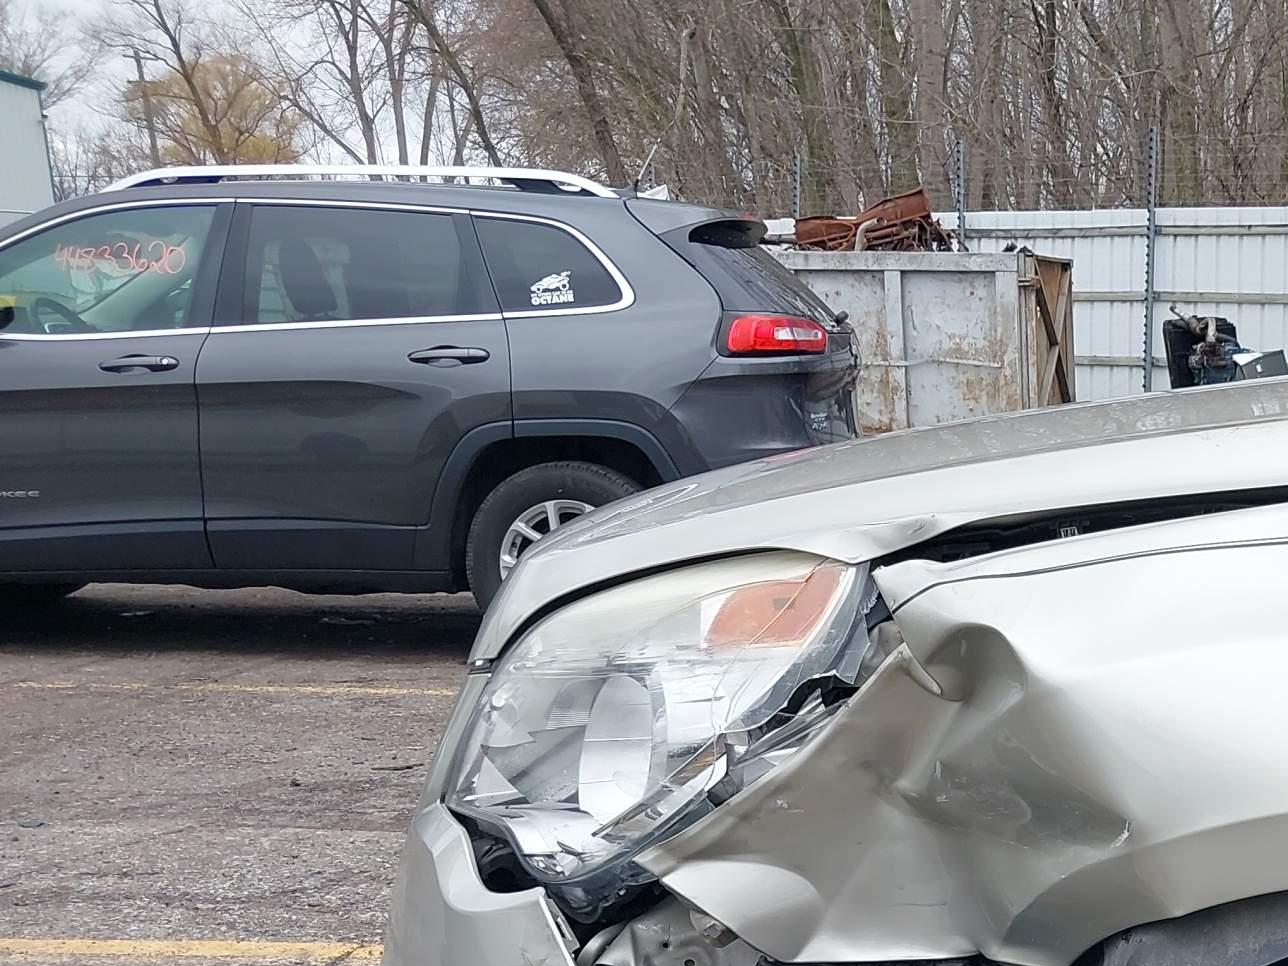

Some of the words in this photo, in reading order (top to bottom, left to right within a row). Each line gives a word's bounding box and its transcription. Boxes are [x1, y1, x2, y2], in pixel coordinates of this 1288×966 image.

[55, 240, 186, 274] 44833620
[531, 293, 574, 305] OCTANE
[0, 490, 40, 498] KEE
